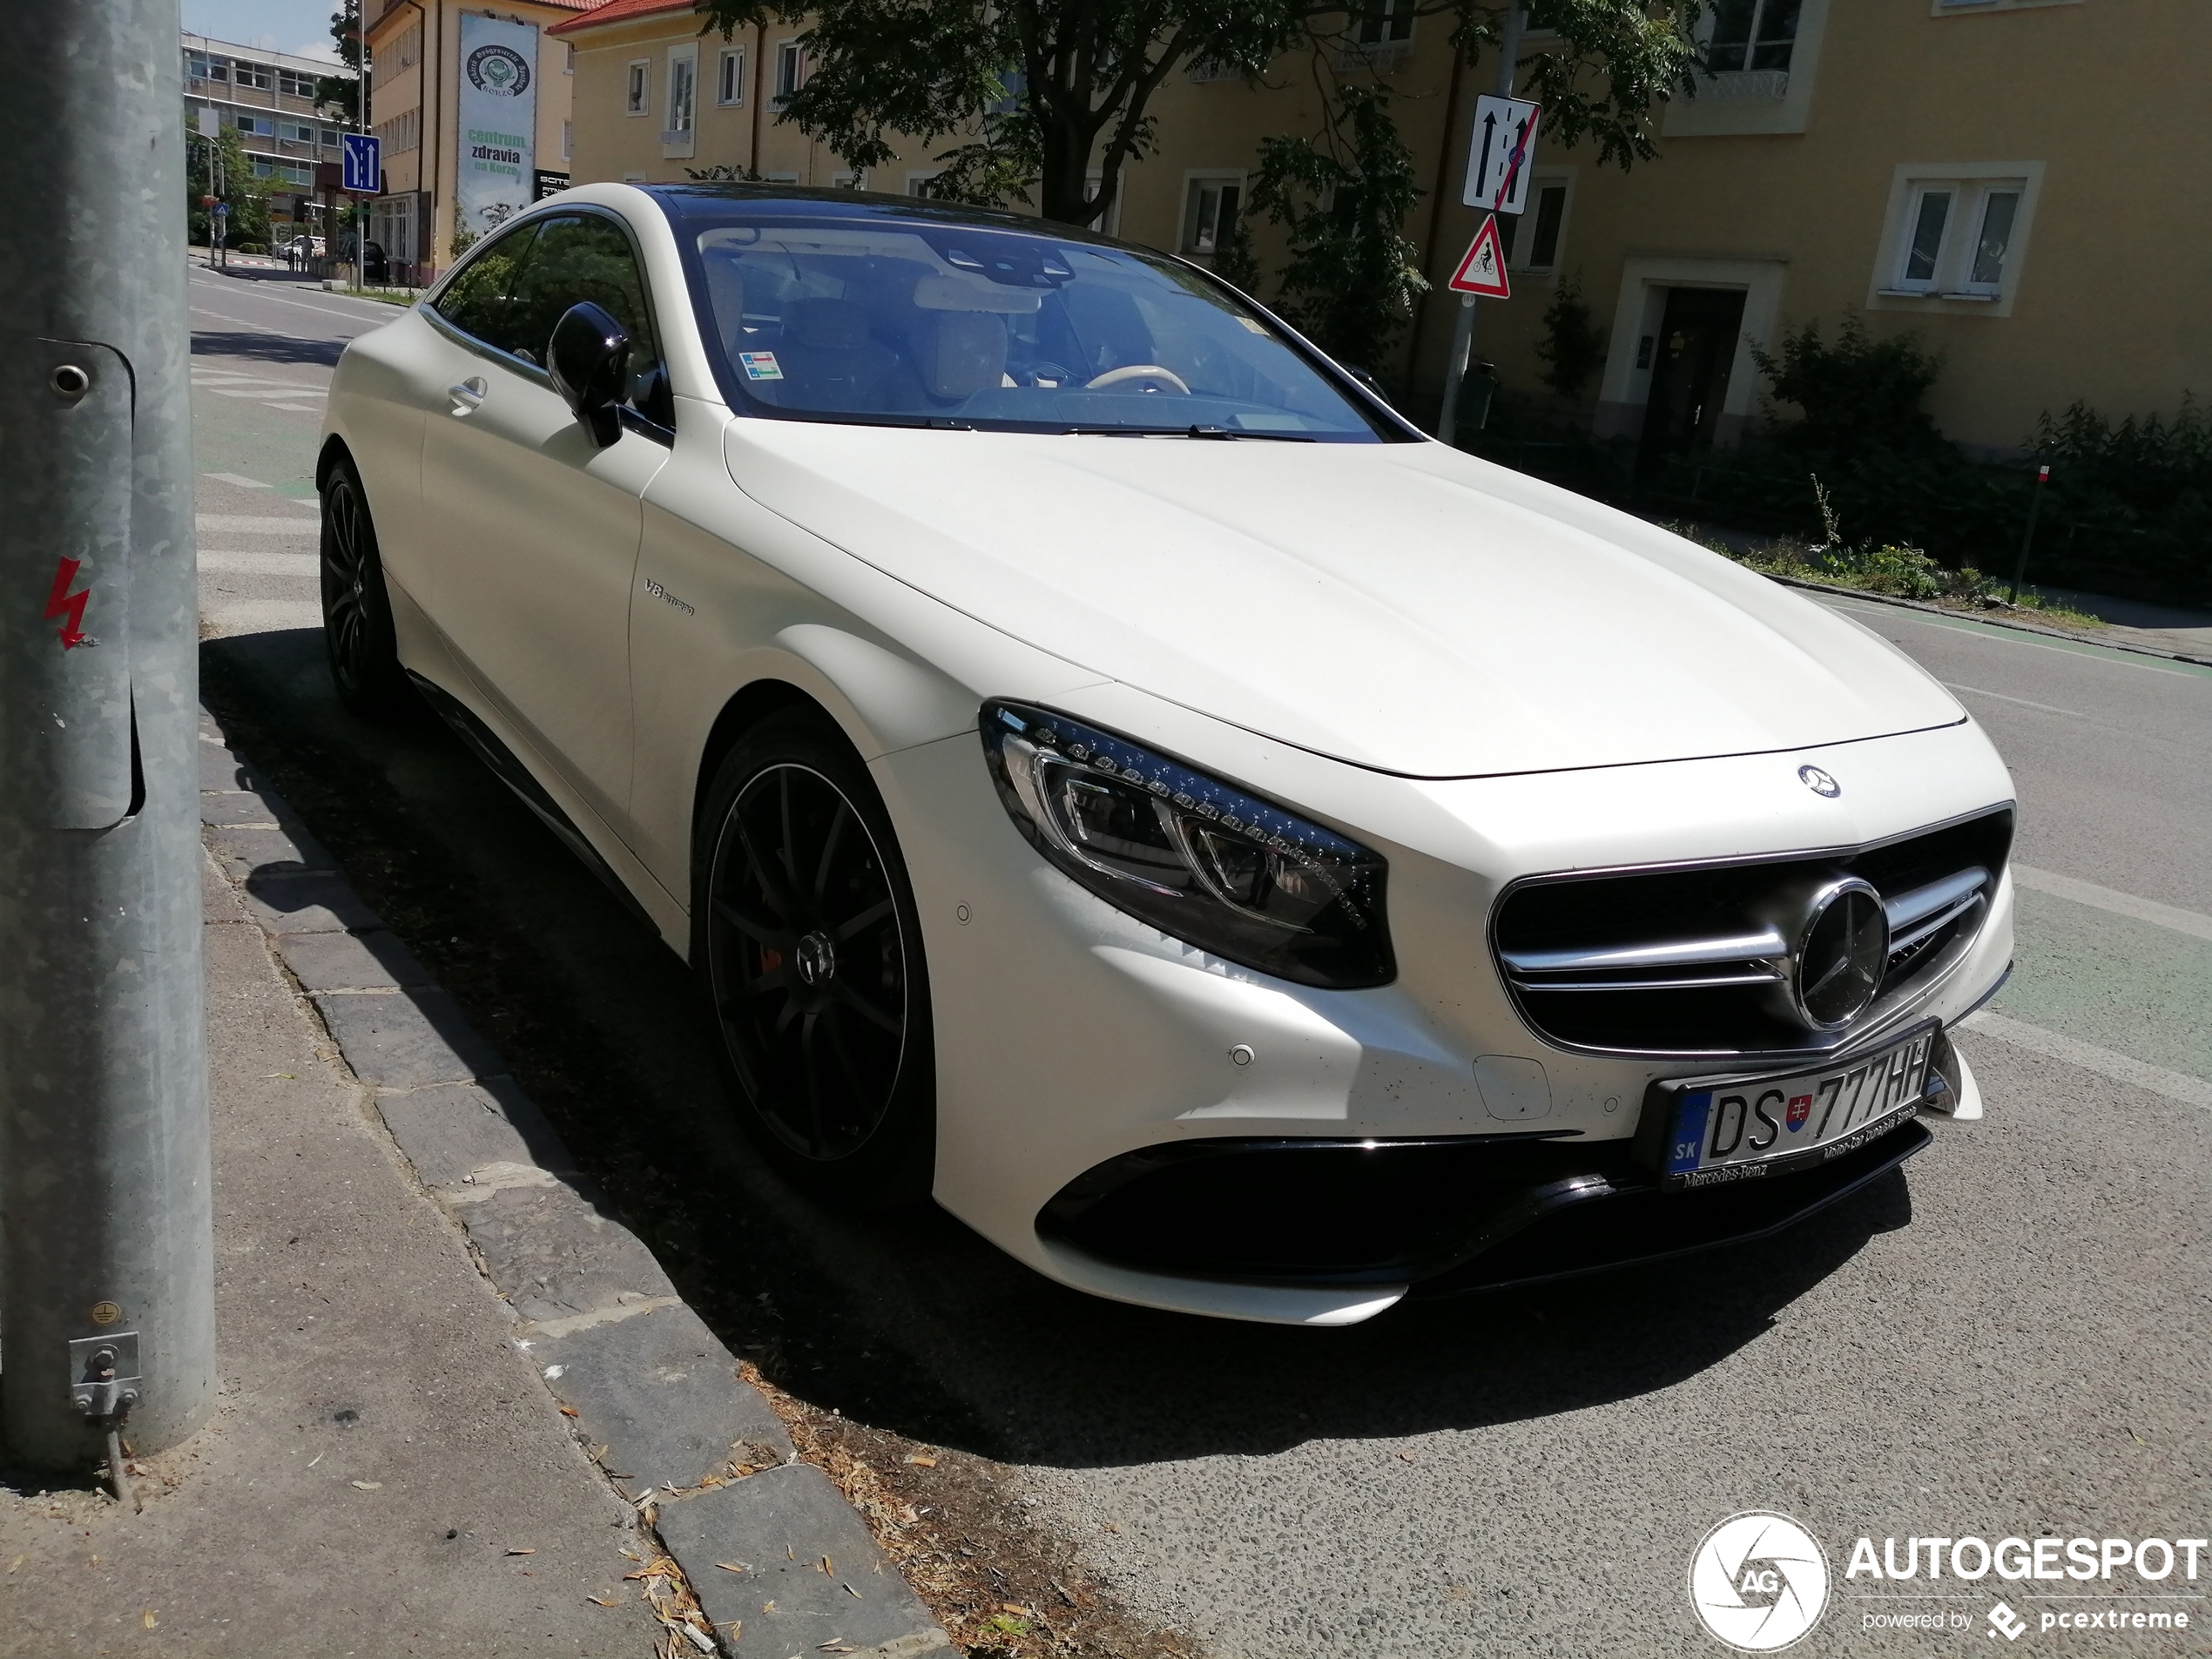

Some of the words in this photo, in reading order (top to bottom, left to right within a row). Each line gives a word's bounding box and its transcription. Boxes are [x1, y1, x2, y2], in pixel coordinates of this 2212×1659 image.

[482, 85, 513, 97] KORZO
[468, 129, 525, 148] centrum
[472, 145, 521, 164] zdravia
[475, 161, 488, 172] na
[644, 578, 664, 597] V8
[662, 592, 695, 616] BITURBO
[1710, 1089, 1785, 1159] DS
[1815, 1033, 1933, 1139] 777HH
[1675, 1142, 1697, 1160] SK
[1683, 1164, 1769, 1188] Mercedes-Benz
